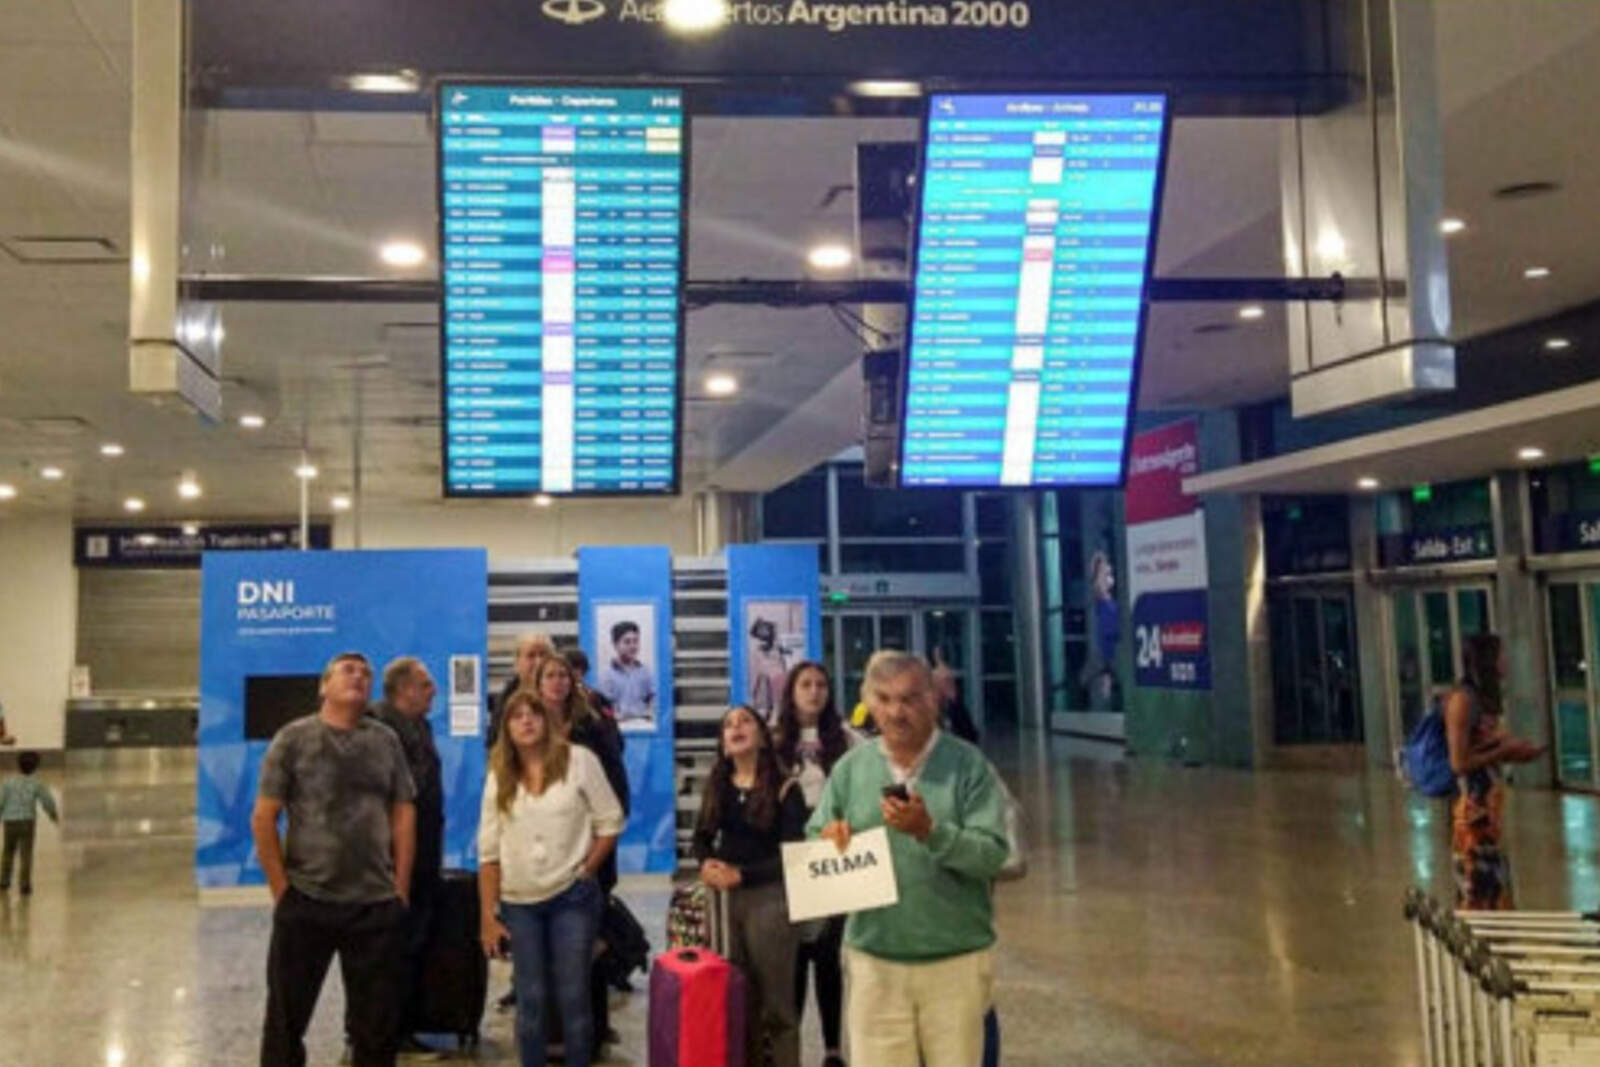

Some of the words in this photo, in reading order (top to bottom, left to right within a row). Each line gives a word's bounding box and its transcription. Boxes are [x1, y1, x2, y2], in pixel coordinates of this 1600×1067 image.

[618, 0, 784, 25] Aerertos
[787, 0, 948, 32] Argentina
[952, 1, 1029, 28] 2000
[236, 580, 295, 604] DNI
[236, 604, 335, 620] PASAPORTE
[1135, 624, 1163, 668] 24
[808, 851, 878, 878] SELMA
